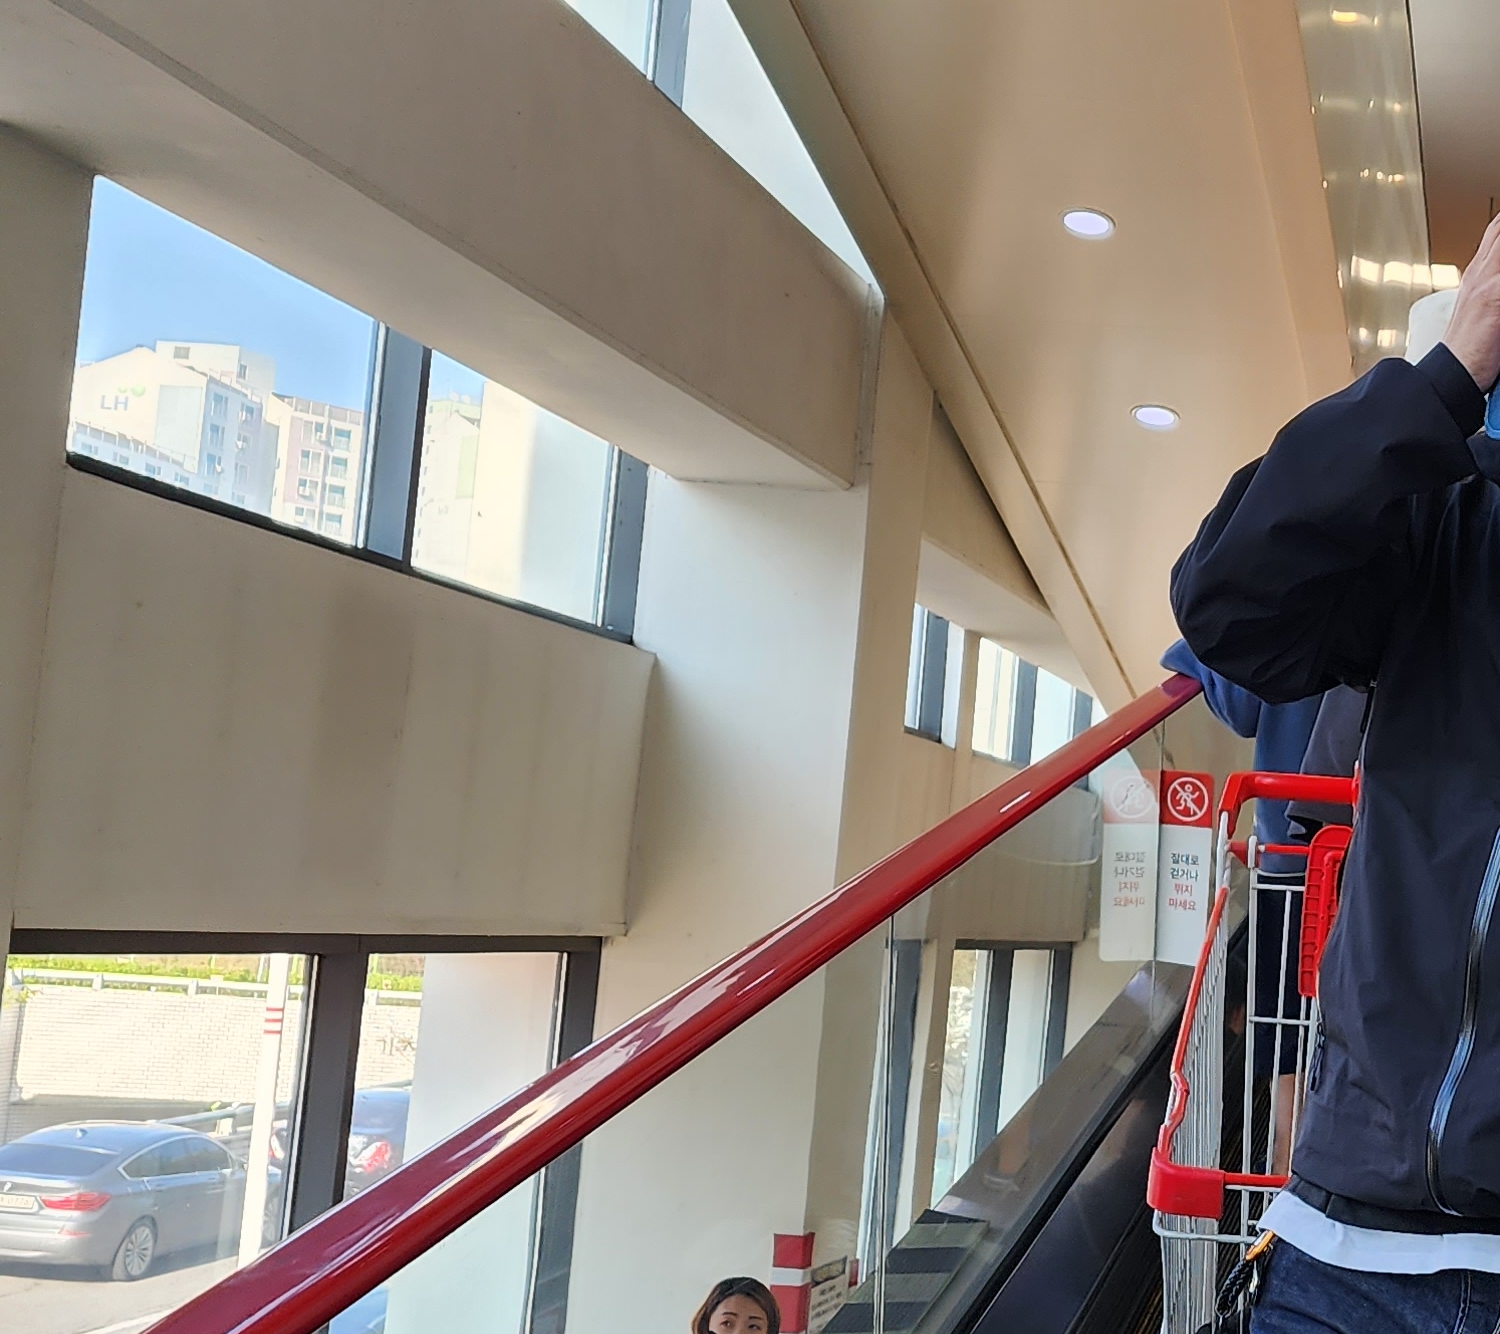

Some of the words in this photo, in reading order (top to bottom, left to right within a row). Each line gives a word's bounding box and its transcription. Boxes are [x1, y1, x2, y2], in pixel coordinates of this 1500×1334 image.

[100, 395, 129, 411] LH
[1171, 852, 1199, 866] 절대로
[1170, 867, 1199, 882] 걷거나
[1168, 897, 1197, 911] 마세요
